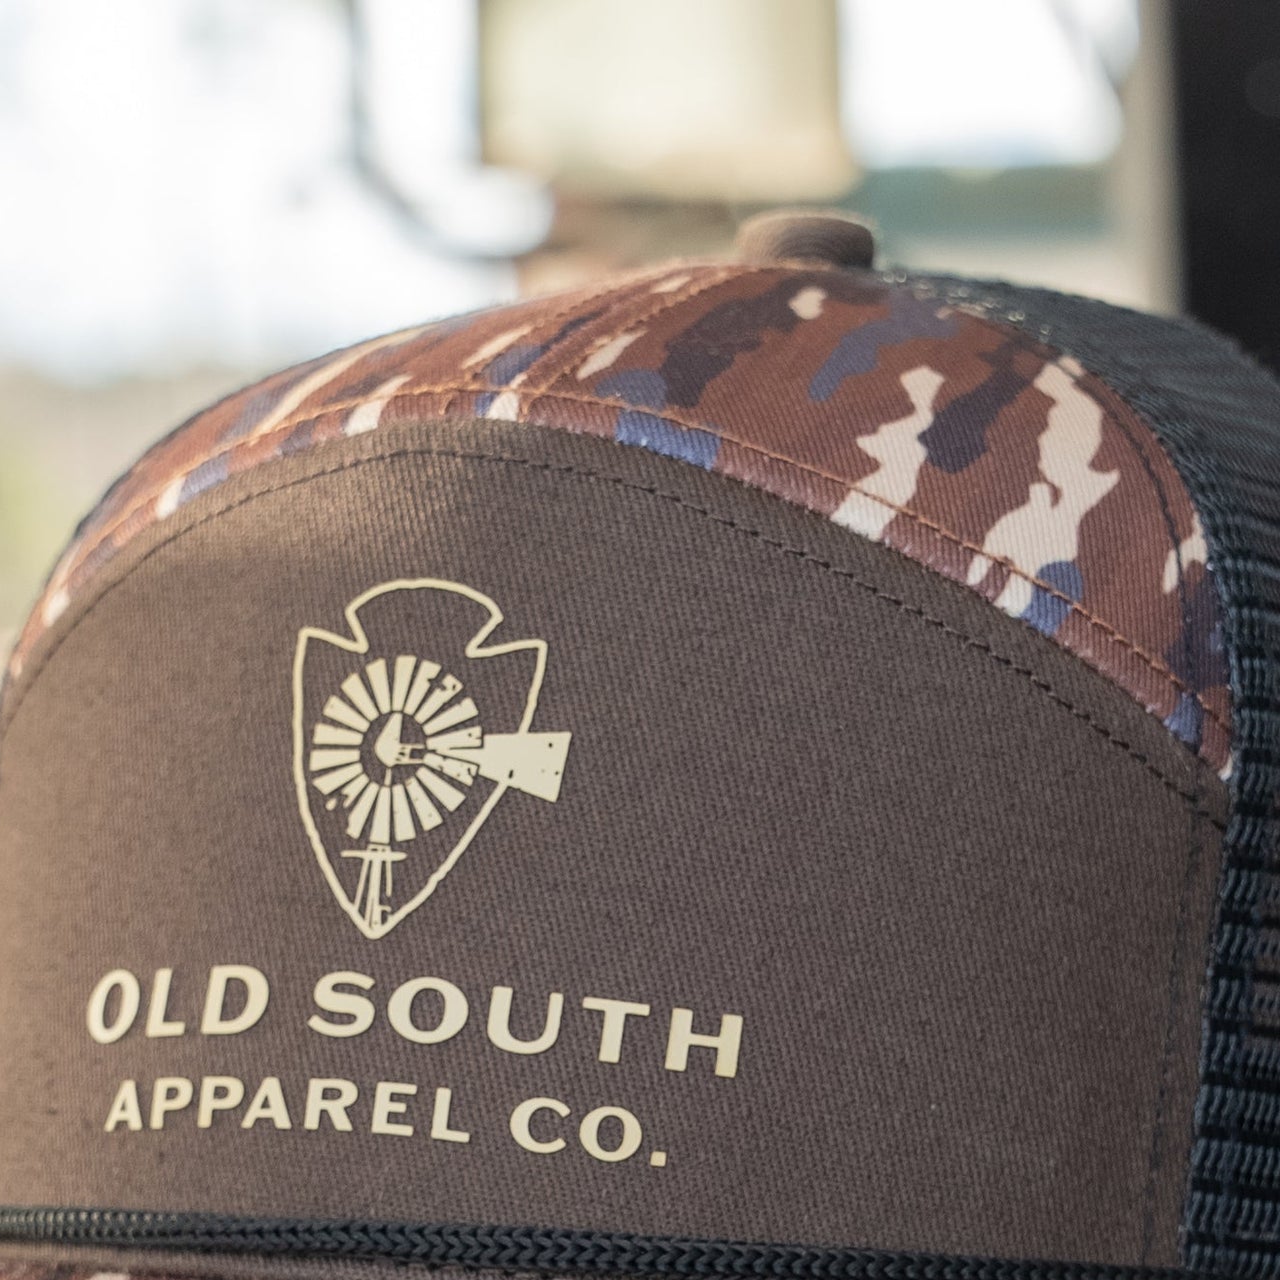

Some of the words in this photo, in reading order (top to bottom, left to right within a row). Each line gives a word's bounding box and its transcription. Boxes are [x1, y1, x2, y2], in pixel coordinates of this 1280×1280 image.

[86, 964, 270, 1044] OLD
[308, 971, 744, 1078] SOUTH
[104, 1076, 471, 1143] APPAREL
[509, 1097, 667, 1167] CO.
